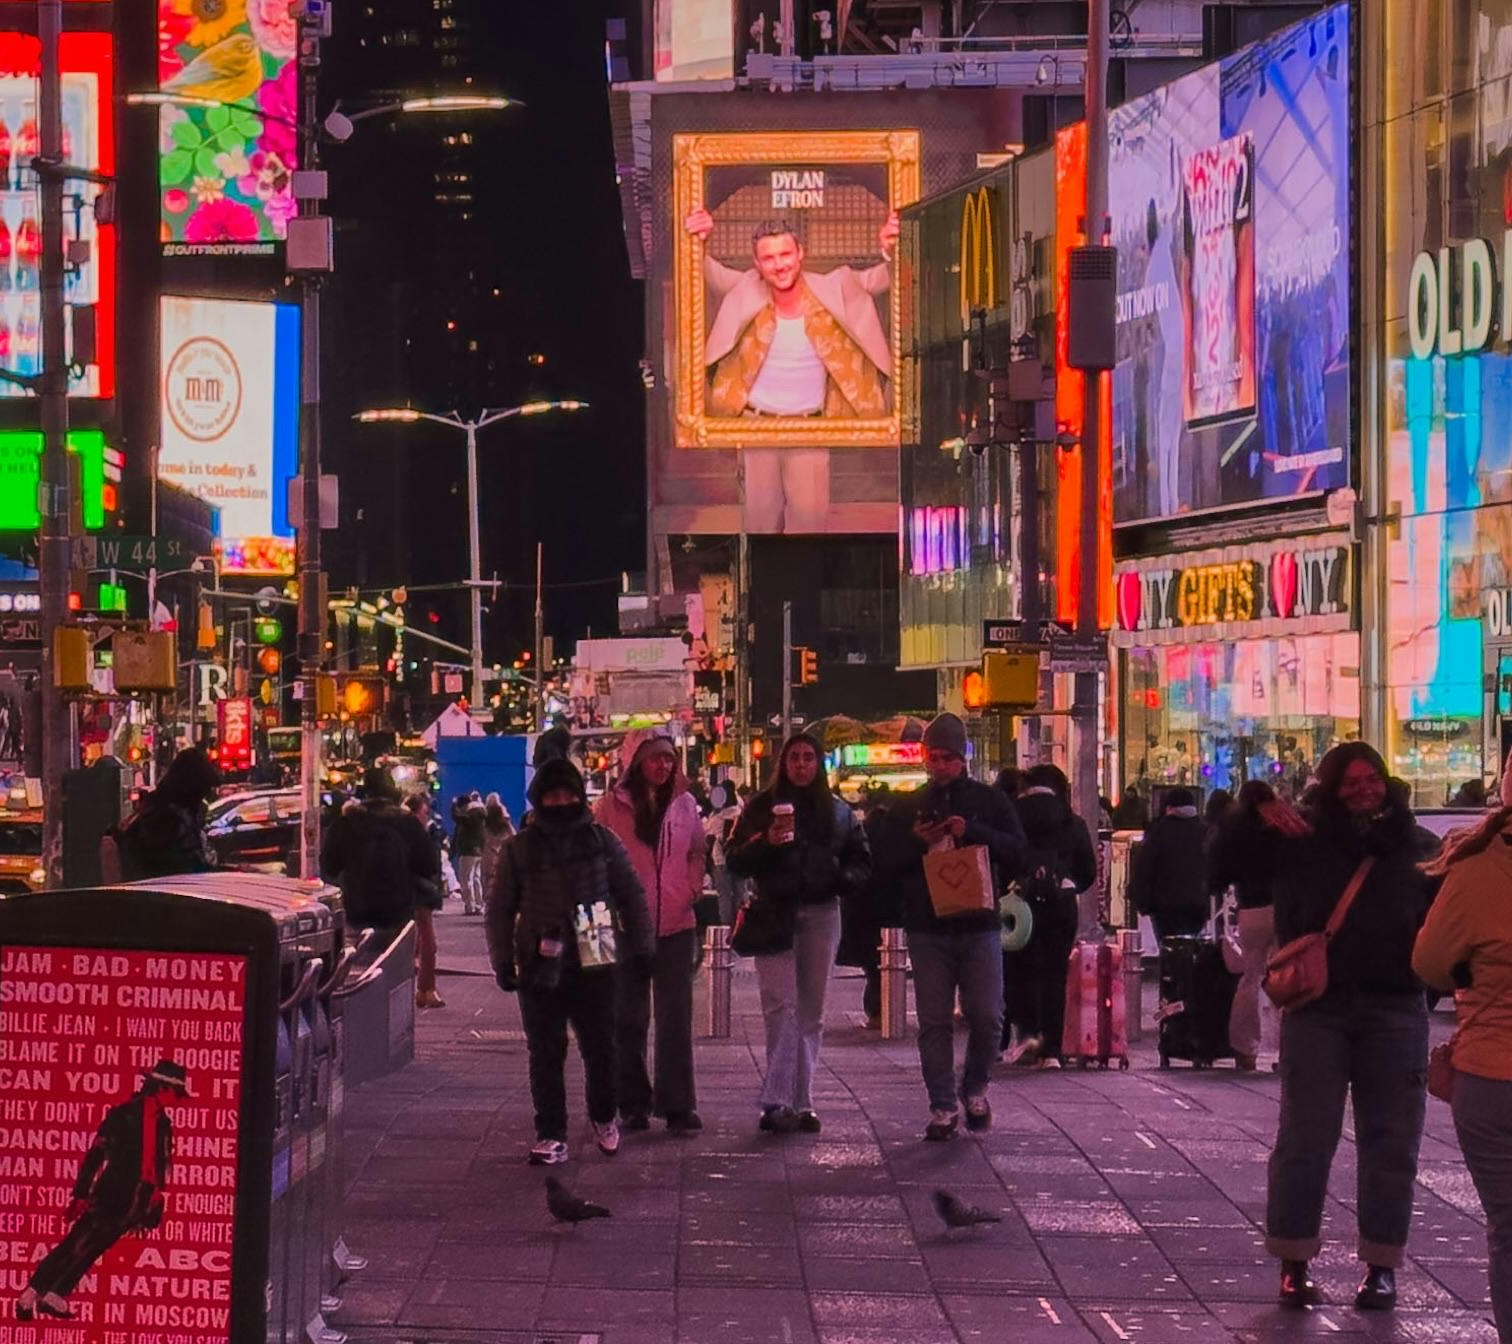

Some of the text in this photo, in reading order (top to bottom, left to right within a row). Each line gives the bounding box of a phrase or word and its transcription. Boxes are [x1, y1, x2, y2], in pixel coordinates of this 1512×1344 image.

[771, 171, 824, 190] DYLAN
[772, 191, 824, 208] EFRON
[1408, 238, 1493, 360] OLD
[7, 463, 40, 475] HEL
[158, 463, 185, 475] ome
[189, 460, 202, 475] in
[205, 460, 245, 479] today
[102, 540, 181, 564] W 44 St
[14, 594, 40, 611] ON
[1178, 560, 1254, 626] GIFTS
[198, 664, 228, 705] R
[1, 953, 244, 982] JAM BAD MONEY
[0, 981, 243, 1012] SMOOTH CRIMINAL
[53, 1014, 96, 1036] JEAN
[116, 1017, 121, 1037] I
[127, 1018, 165, 1039] WANT
[171, 1020, 200, 1041] YOU
[205, 1021, 242, 1043] BACK
[68, 1043, 85, 1064] IT
[94, 1045, 119, 1066] ON
[129, 1046, 164, 1068] THE
[173, 1048, 240, 1071] BOOGIE
[65, 1071, 120, 1094] YOU
[212, 1077, 239, 1099] IT
[45, 1101, 95, 1124] DON'T
[216, 1109, 238, 1130] US
[55, 1159, 78, 1181] IN
[176, 1193, 234, 1216] ENOUGH
[30, 1214, 56, 1235] THE
[165, 1220, 183, 1241] OR
[189, 1222, 233, 1244] WHITE
[134, 1247, 230, 1272] ABC
[110, 1275, 230, 1300] NATURE
[104, 1303, 125, 1324] IN
[136, 1305, 229, 1329] MOSCOW
